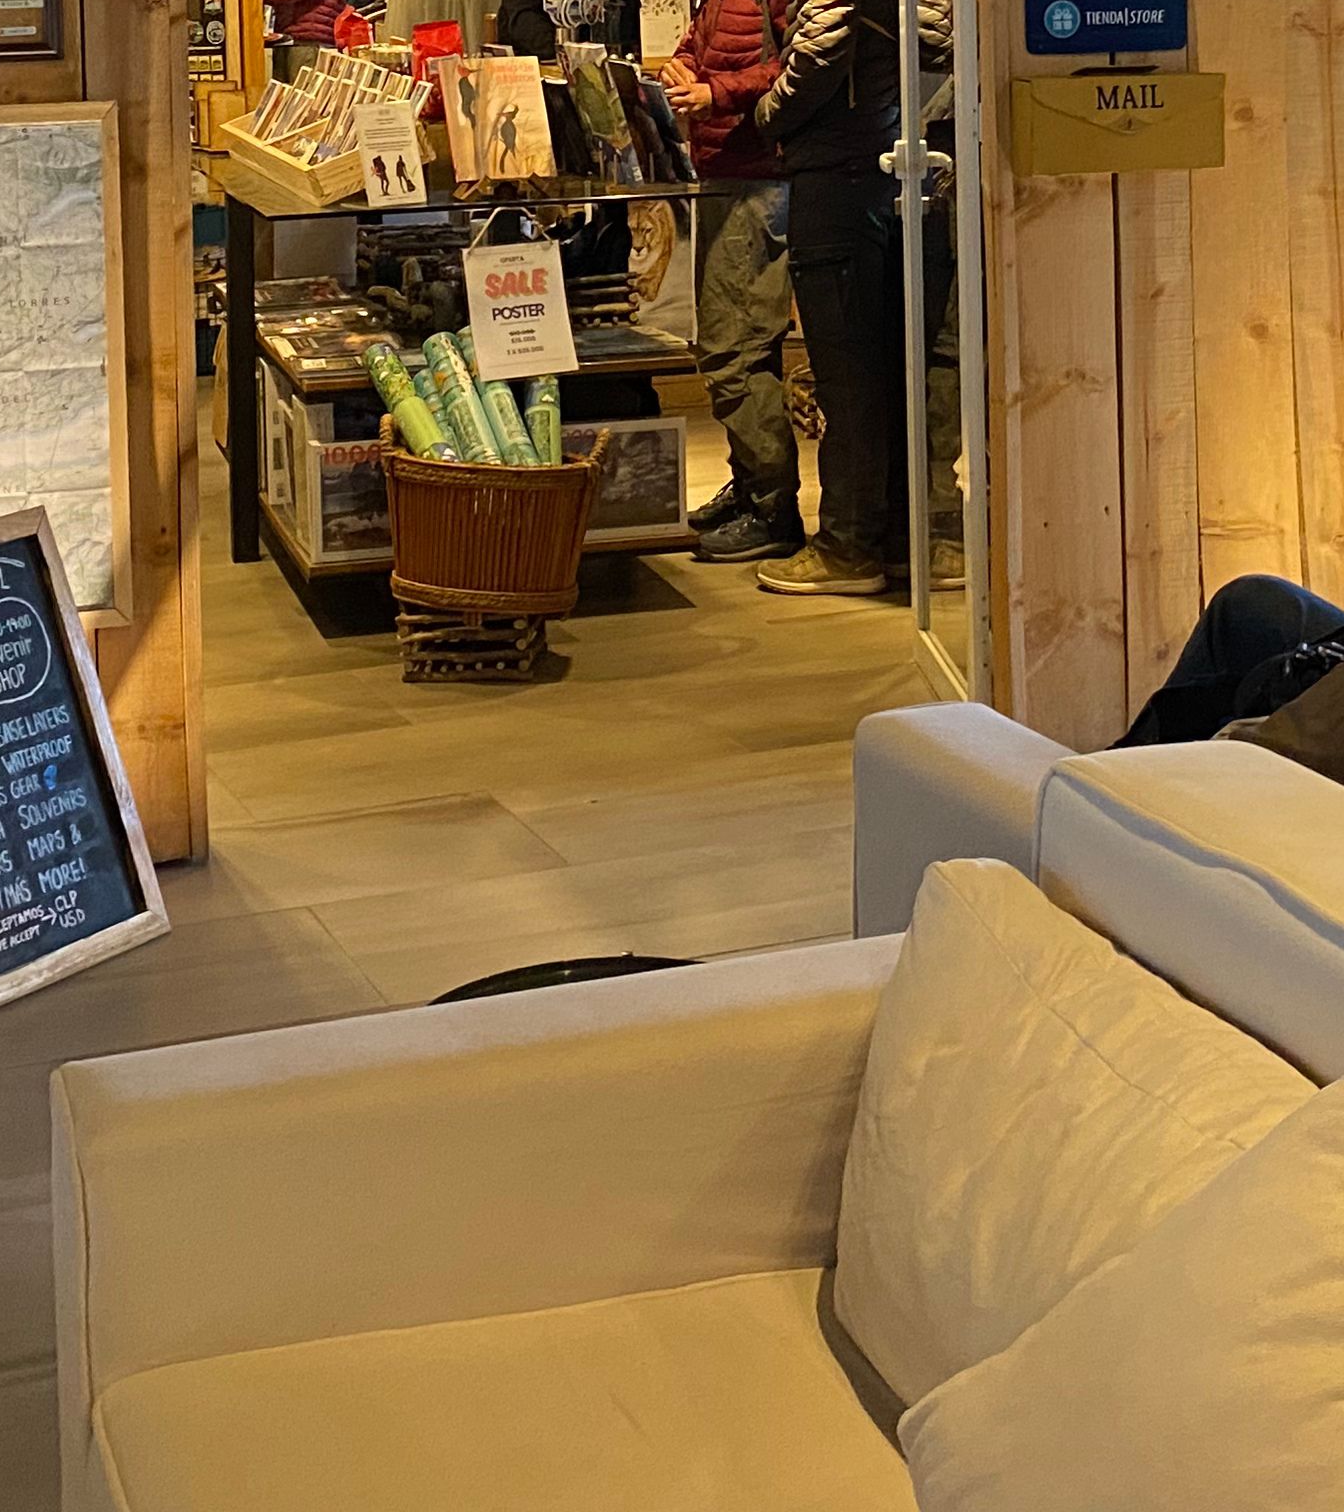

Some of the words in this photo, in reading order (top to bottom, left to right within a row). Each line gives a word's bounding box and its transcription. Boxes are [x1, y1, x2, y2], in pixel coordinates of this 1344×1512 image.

[1096, 84, 1164, 111] MAIL
[484, 268, 549, 301] SALE
[492, 303, 545, 321] POSTER
[25, 704, 70, 736] LAYERS
[0, 735, 73, 776] WATERPROOF
[10, 774, 42, 799] GEAR
[26, 830, 66, 861] MAPS
[38, 857, 87, 893] MORE!
[54, 890, 78, 912] CLP
[58, 908, 86, 929] USD
[9, 925, 41, 948] ACCEPT
